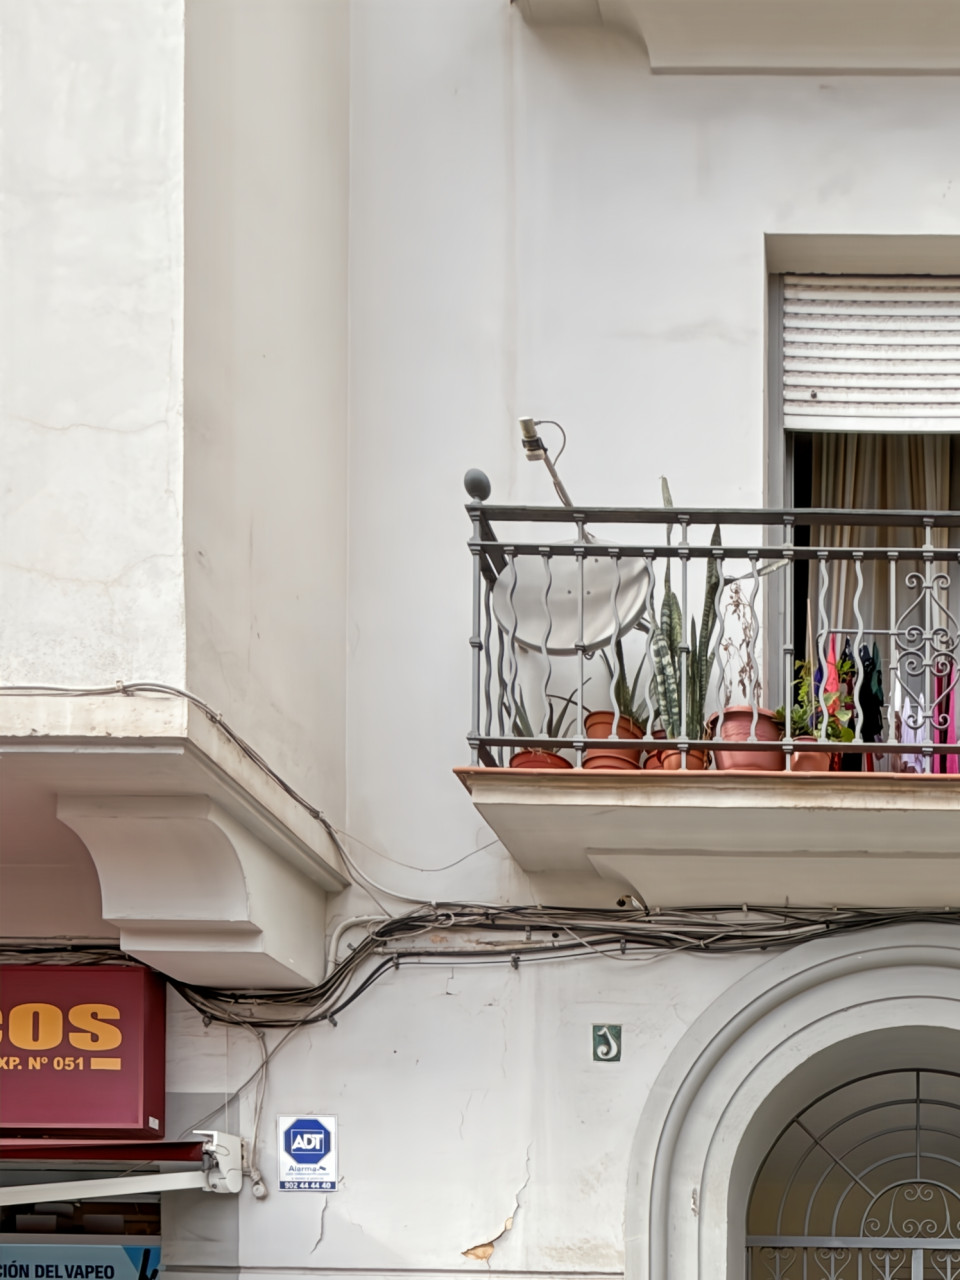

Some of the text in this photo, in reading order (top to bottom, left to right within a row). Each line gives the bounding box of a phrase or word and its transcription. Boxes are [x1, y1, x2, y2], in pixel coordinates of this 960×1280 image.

[0, 1003, 122, 1051] OS
[28, 1057, 48, 1070] Nº
[53, 1057, 84, 1070] 051
[291, 1134, 324, 1150] ADT
[0, 1260, 115, 1279] IÓN DEL VAPEO
